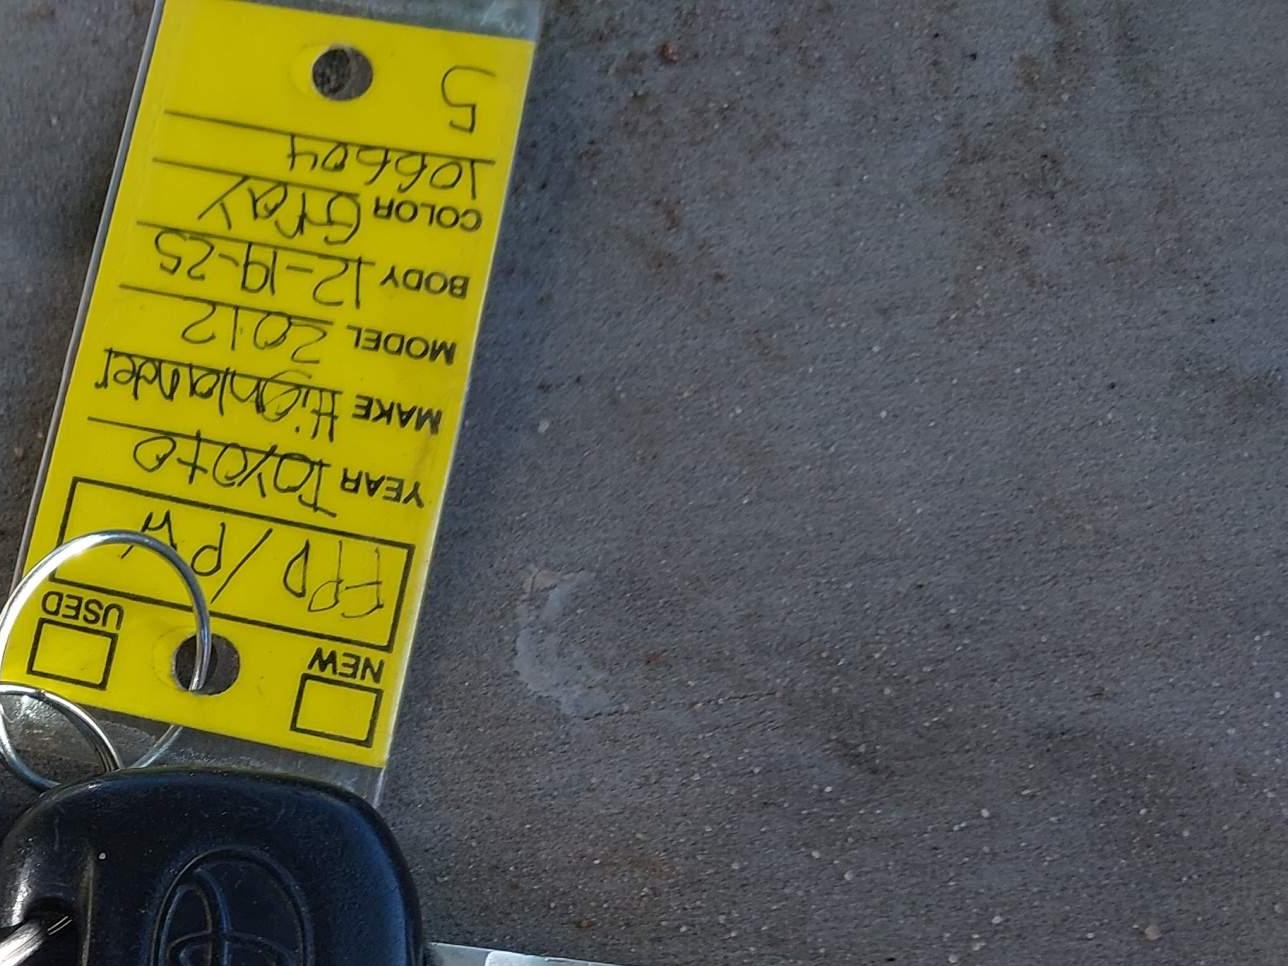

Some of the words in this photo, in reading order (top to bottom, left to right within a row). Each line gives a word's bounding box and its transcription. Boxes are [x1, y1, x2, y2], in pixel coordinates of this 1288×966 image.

[440, 65, 496, 134] 5
[288, 133, 480, 200] 106604
[198, 176, 361, 246] Gray
[372, 200, 482, 233] COLOR
[153, 230, 362, 310] 12-19-25
[379, 266, 470, 300] BODY
[180, 303, 328, 365] 2012
[346, 324, 457, 365] MODEL
[94, 348, 339, 442] Highlander
[352, 393, 444, 435] MAKE
[340, 467, 425, 508] YEAR
[42, 591, 124, 631] USED
[309, 646, 385, 684] NEW
